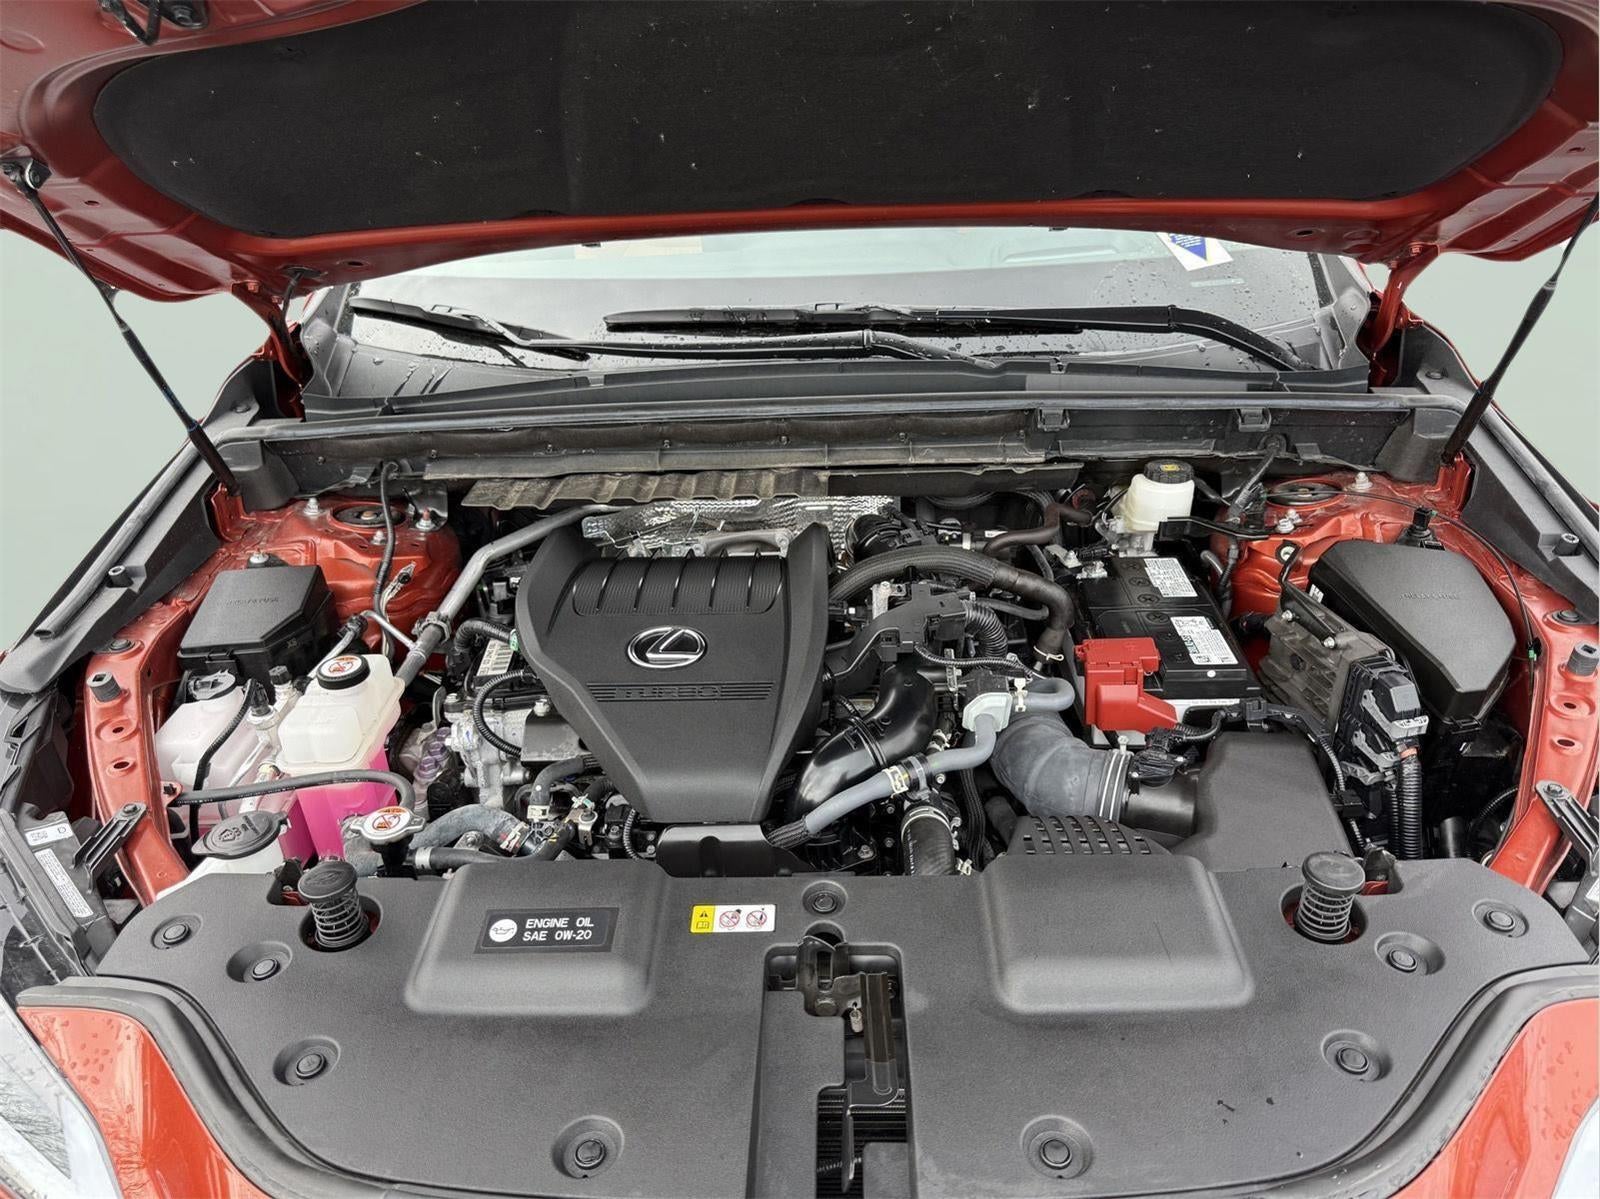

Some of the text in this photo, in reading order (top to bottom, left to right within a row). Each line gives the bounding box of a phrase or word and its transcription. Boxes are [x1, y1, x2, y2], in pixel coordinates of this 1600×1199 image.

[525, 918, 594, 928] ENGINE OIL
[522, 930, 592, 941] SAE 0W-20
